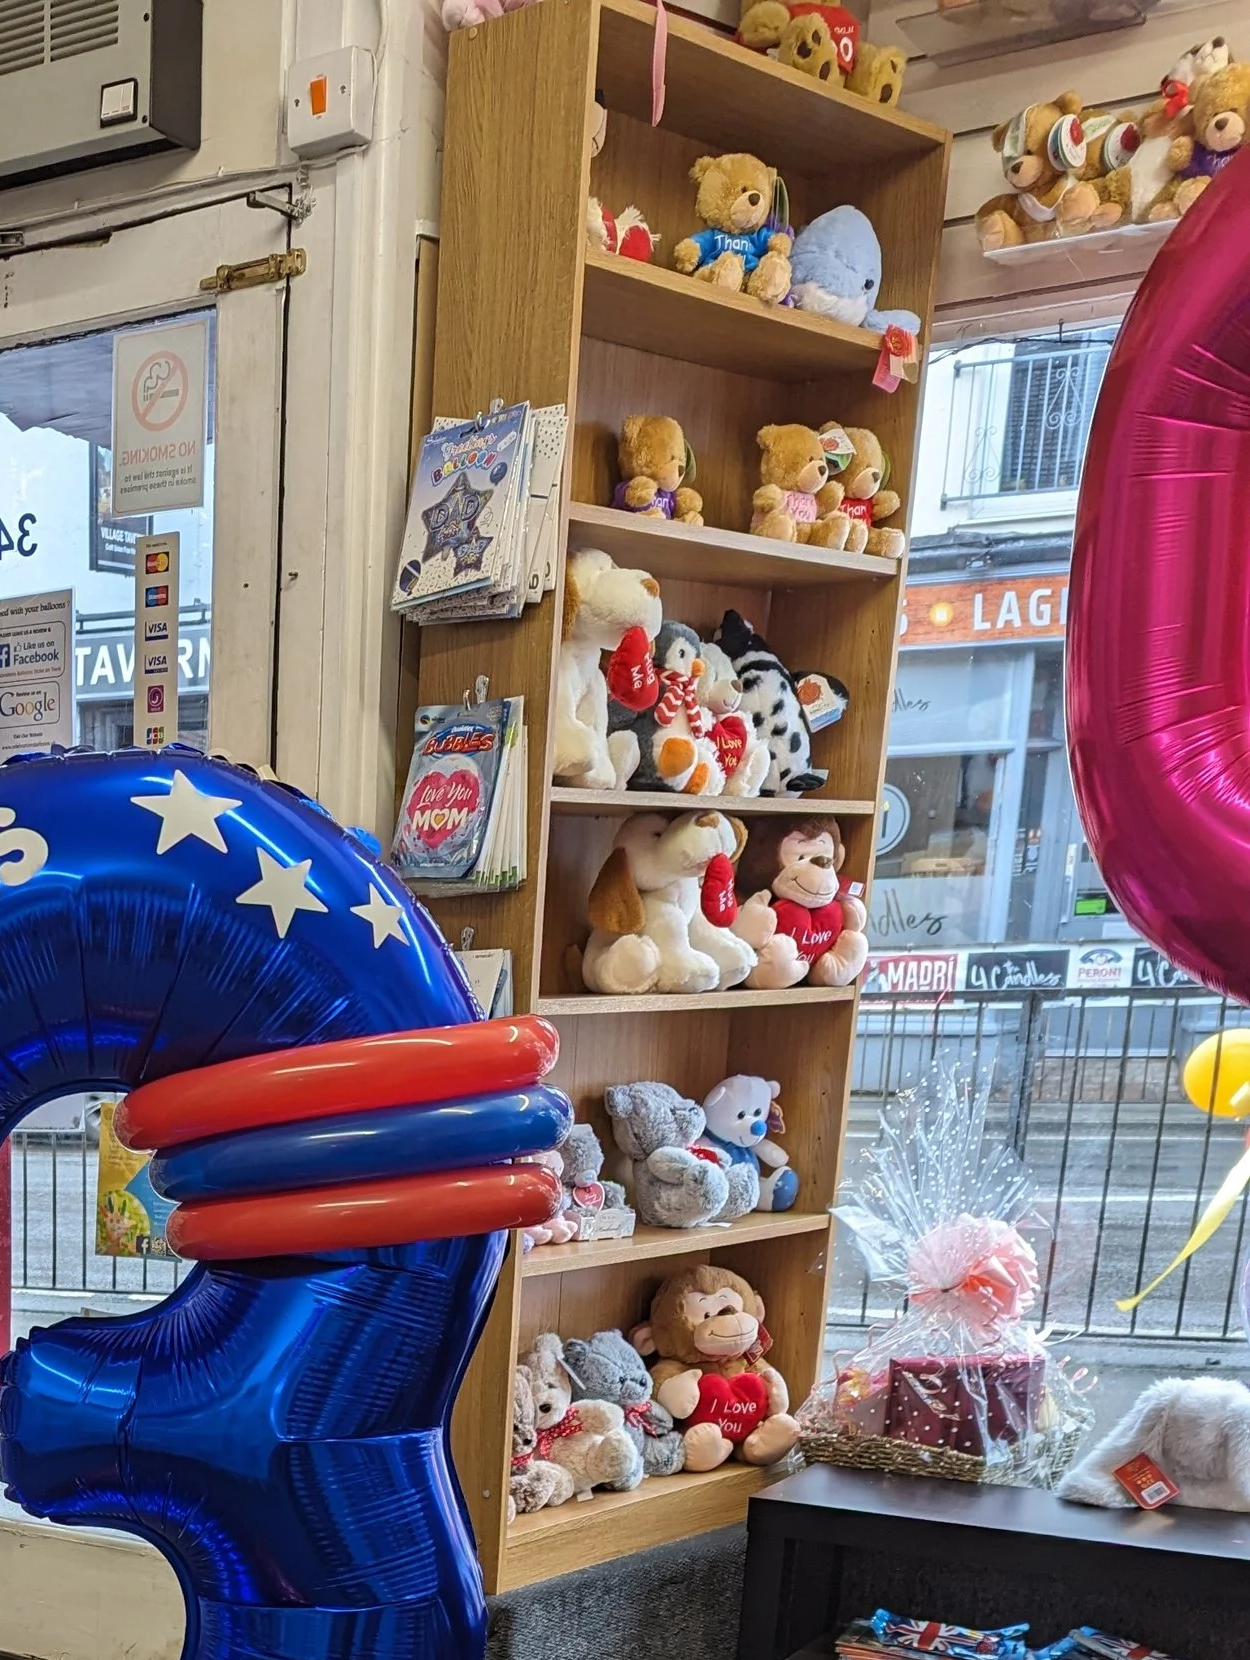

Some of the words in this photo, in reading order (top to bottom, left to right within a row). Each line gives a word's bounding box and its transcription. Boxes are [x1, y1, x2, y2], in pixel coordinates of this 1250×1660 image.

[714, 234, 751, 252] Than
[442, 432, 497, 460] Greetings
[432, 450, 497, 487] BALLOON
[430, 492, 482, 532] DAD
[100, 526, 124, 542] VILLAGE
[10, 606, 23, 615] with
[24, 606, 39, 616] your
[40, 602, 66, 612] balloons
[148, 622, 168, 634] VISA
[23, 642, 37, 651] Like
[46, 640, 55, 648] on
[14, 648, 59, 666] Facebook
[75, 634, 211, 690] TAVRN
[148, 656, 167, 667] VISA
[630, 664, 643, 691] Me
[643, 652, 656, 686] Hug
[423, 731, 496, 757] BUBBLES
[716, 738, 721, 749] I
[721, 738, 743, 750] Love
[724, 754, 738, 768] You
[419, 783, 445, 807] Love
[447, 782, 474, 804] You
[718, 892, 725, 913] Me
[790, 926, 797, 941] I
[802, 928, 833, 945] Love
[797, 952, 815, 965] You
[1078, 966, 1122, 979] PERONI
[710, 1398, 717, 1414] I
[724, 1400, 758, 1415] Love
[718, 1417, 743, 1435] You
